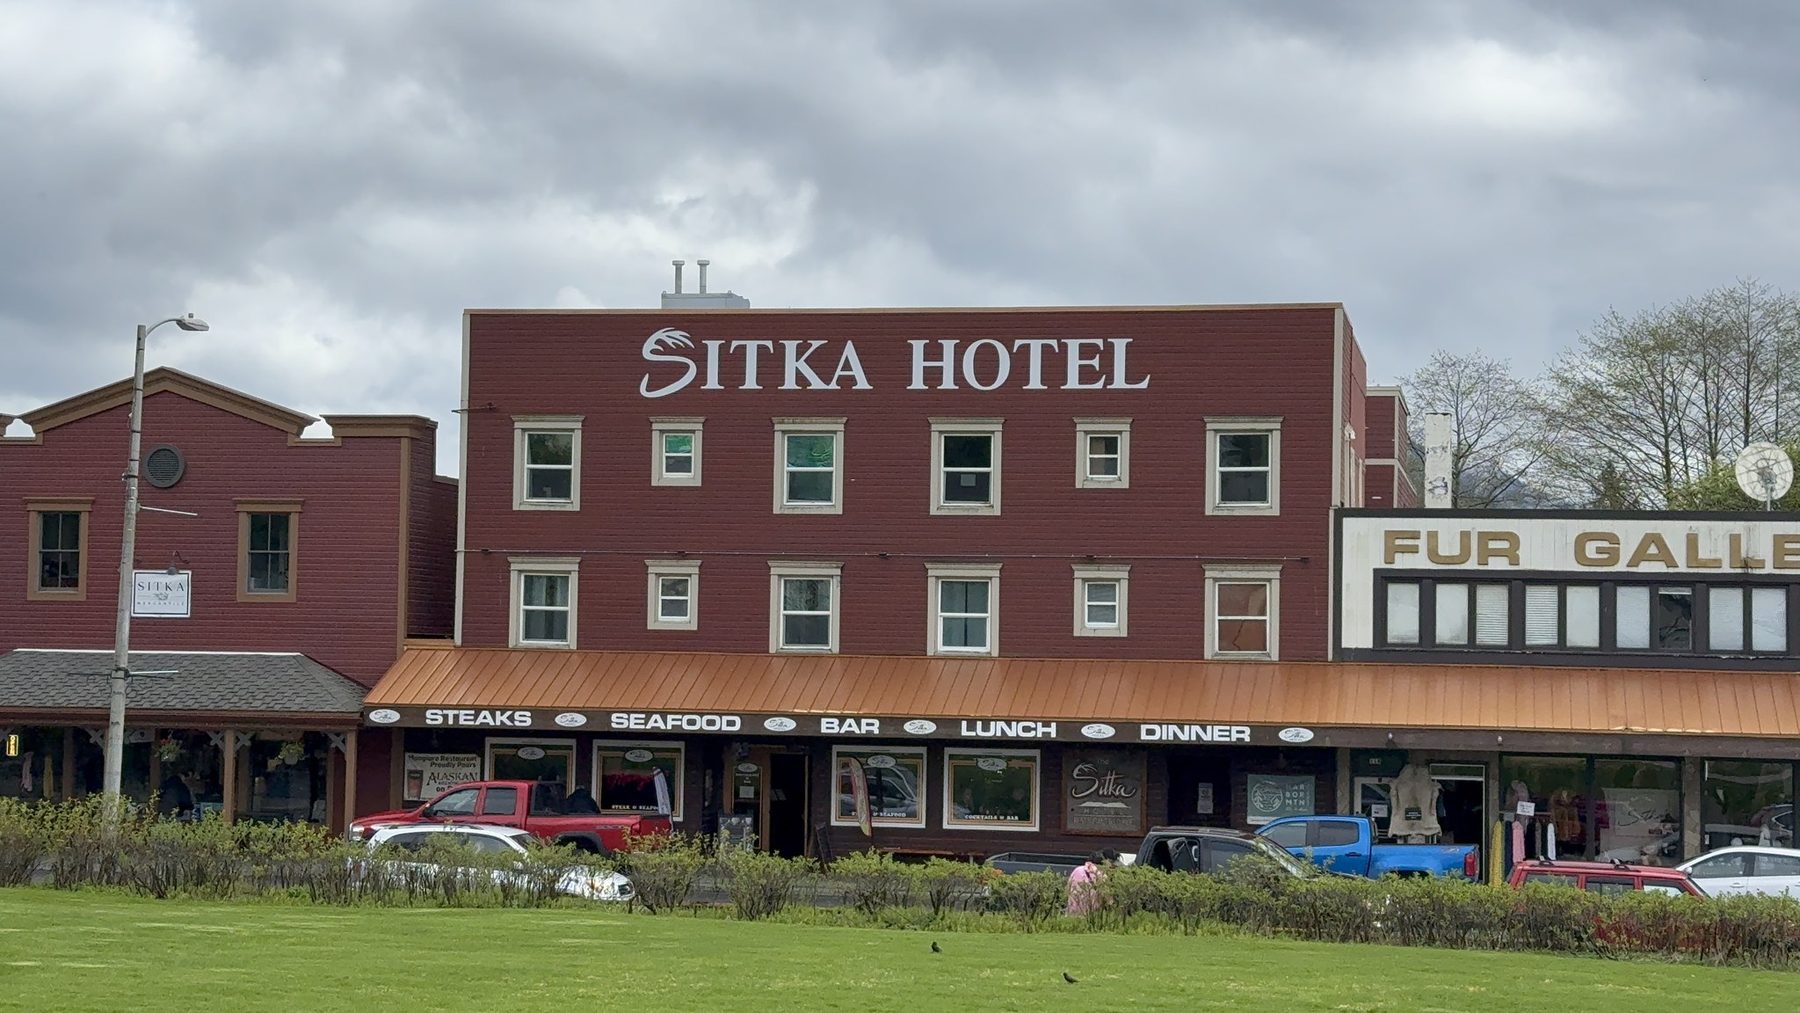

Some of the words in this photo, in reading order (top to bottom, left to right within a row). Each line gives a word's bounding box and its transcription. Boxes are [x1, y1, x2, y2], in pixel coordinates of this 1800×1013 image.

[640, 327, 873, 398] SITKA
[906, 338, 1151, 392] HOTEL
[1383, 529, 1520, 566] FUR
[1573, 531, 1800, 569] GALLE
[137, 581, 185, 592] SITKA
[425, 709, 533, 727] STEAKS
[610, 713, 742, 731] SEAFOOD
[820, 718, 880, 735] BAR
[960, 720, 1057, 738] LUNCH
[1140, 724, 1251, 742] DINNER
[426, 772, 478, 786] ALASKAN
[1071, 762, 1137, 798] Sitka
